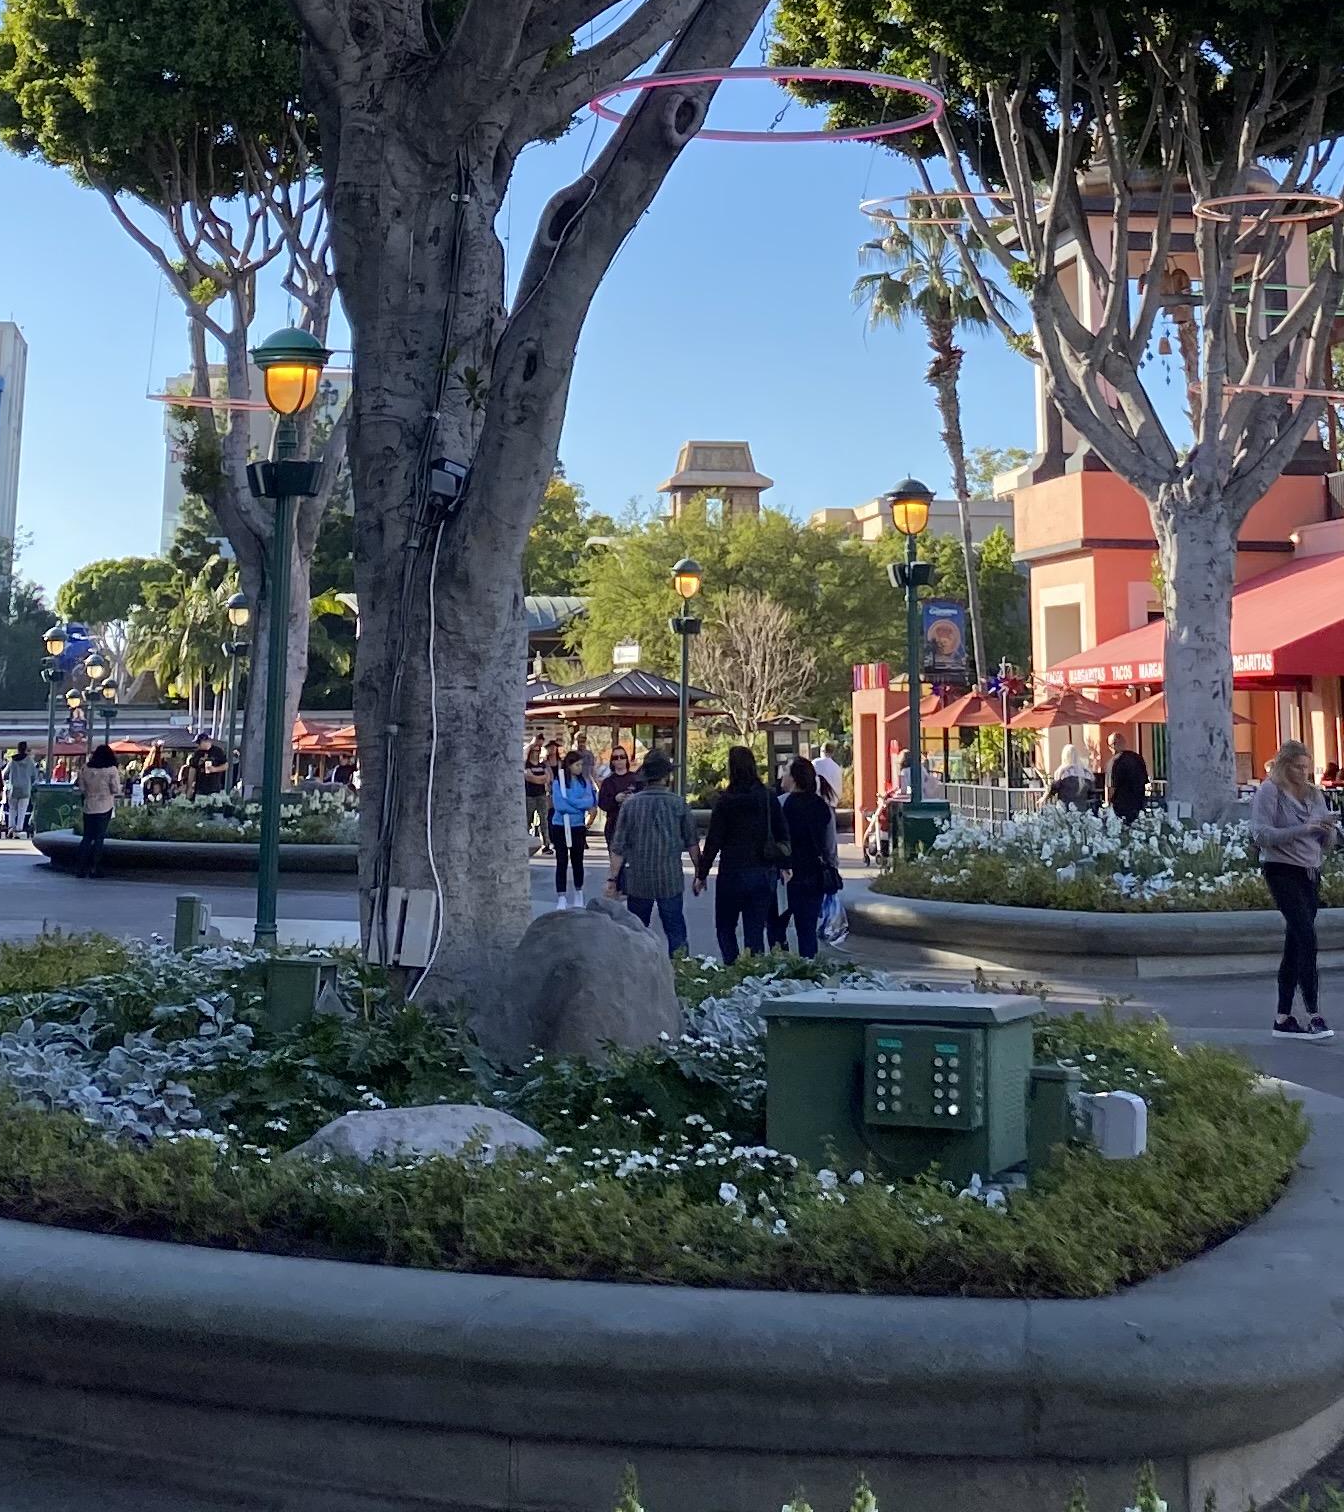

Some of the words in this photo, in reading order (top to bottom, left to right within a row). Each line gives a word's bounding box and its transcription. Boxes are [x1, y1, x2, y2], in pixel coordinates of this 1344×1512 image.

[1069, 666, 1106, 684] MARGARITAS
[1111, 664, 1133, 681] TACOS
[1139, 662, 1163, 679] MARGA
[1233, 653, 1273, 672] RGARITAS
